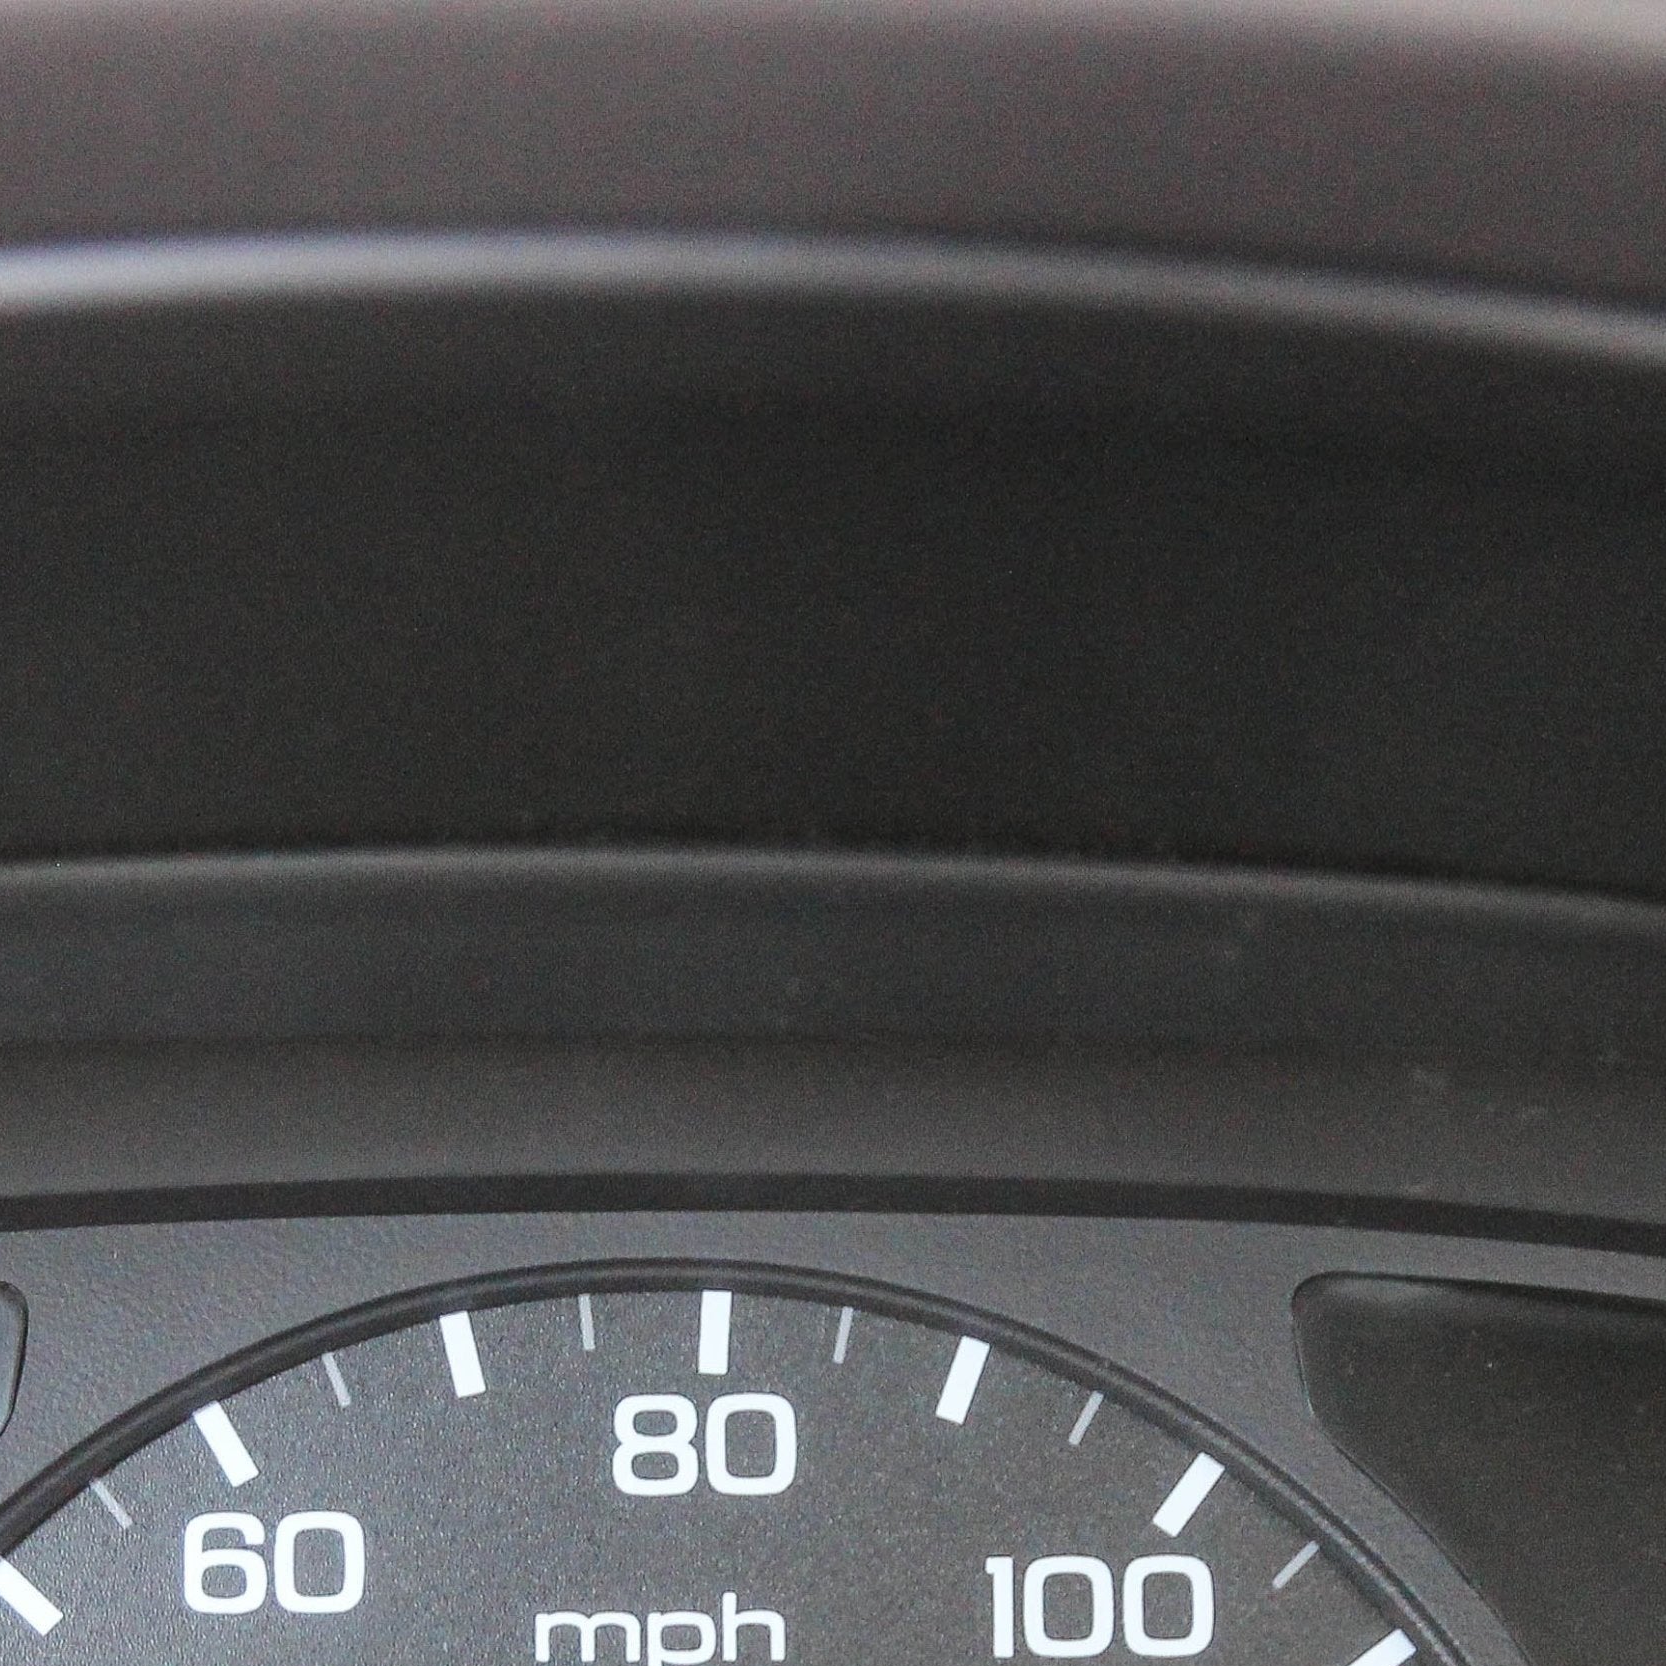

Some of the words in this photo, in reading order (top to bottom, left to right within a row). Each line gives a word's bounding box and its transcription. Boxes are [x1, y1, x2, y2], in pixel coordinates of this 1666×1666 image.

[613, 1394, 796, 1495] 80
[184, 1512, 364, 1613] 60
[986, 1556, 1213, 1657] 100
